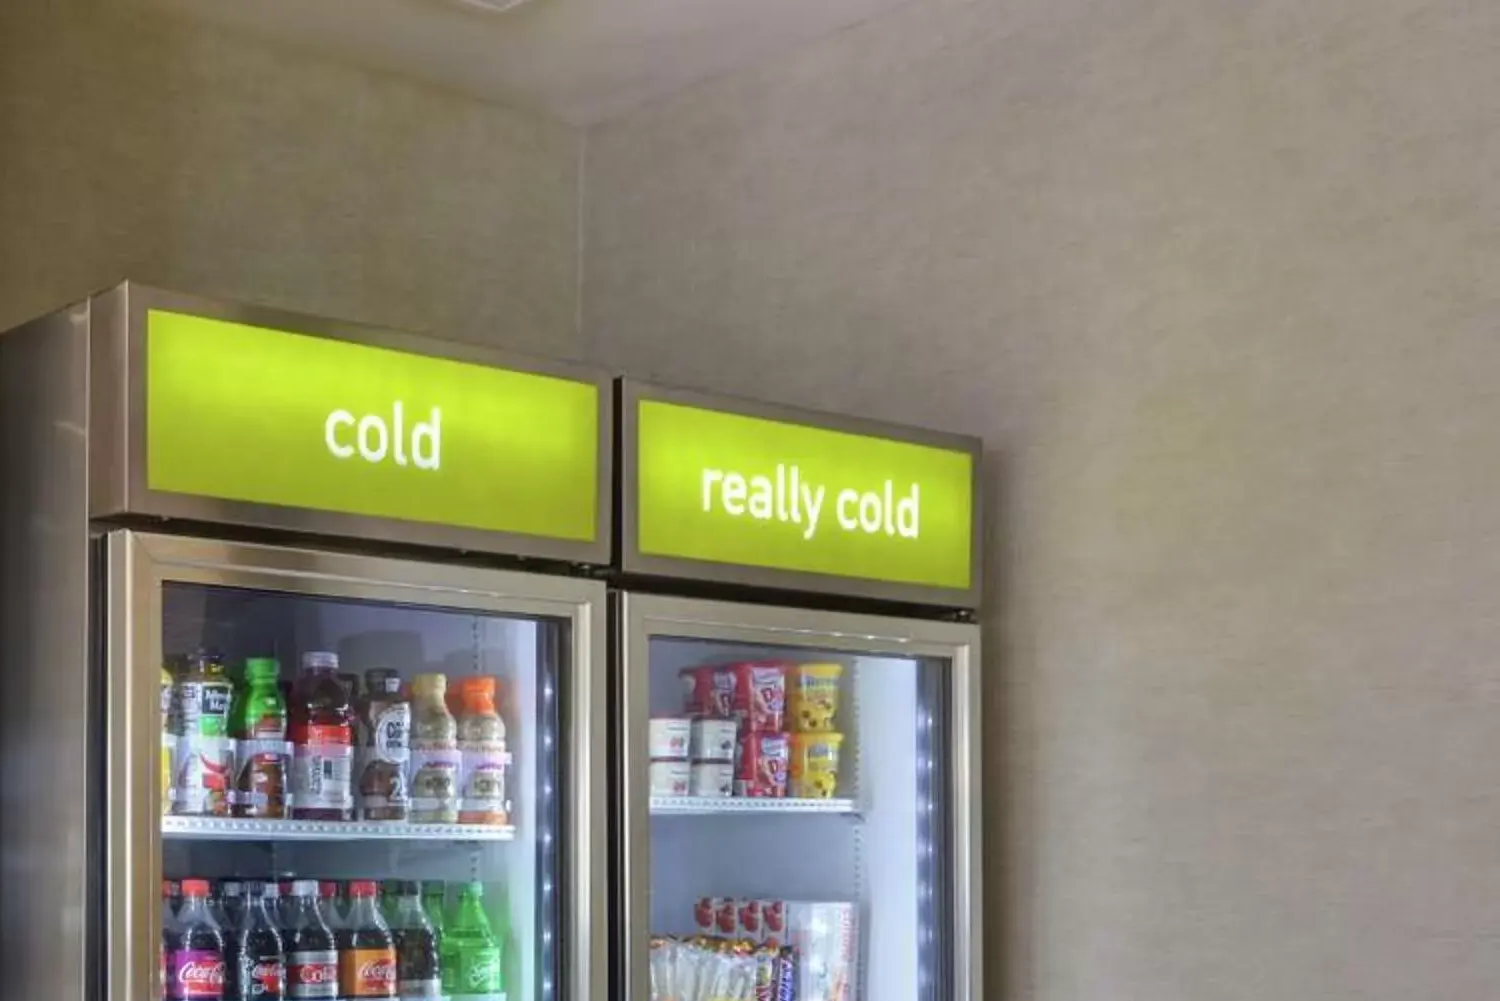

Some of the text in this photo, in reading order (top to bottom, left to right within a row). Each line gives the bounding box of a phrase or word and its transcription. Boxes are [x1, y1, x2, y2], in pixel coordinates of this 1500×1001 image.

[324, 400, 442, 470] cold
[702, 464, 920, 540] really cold
